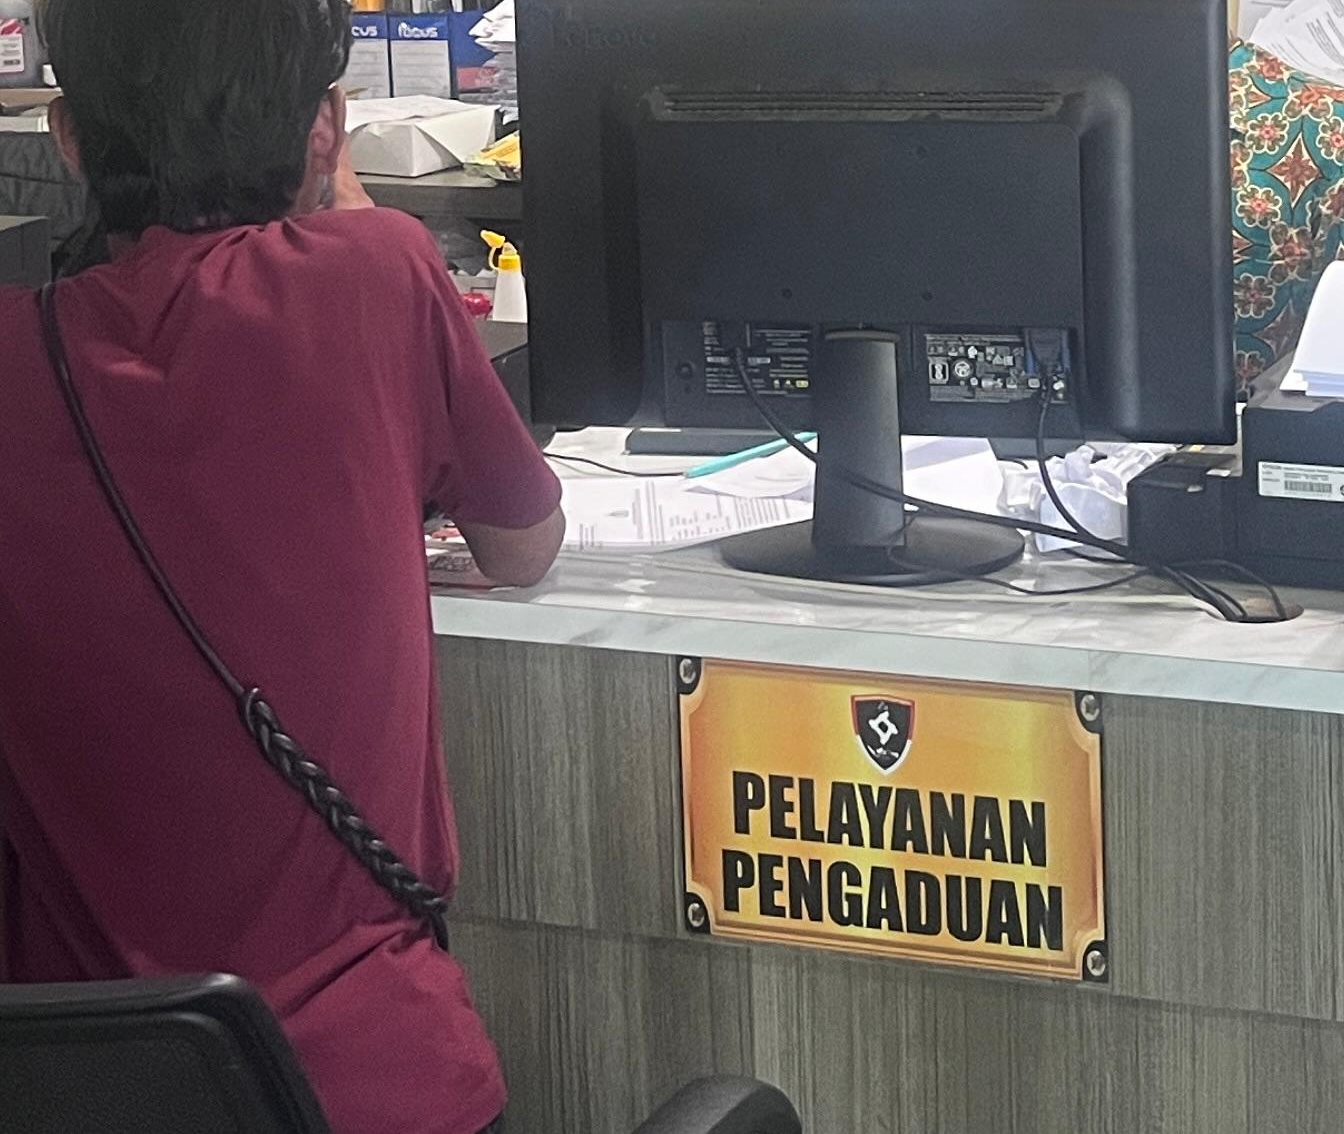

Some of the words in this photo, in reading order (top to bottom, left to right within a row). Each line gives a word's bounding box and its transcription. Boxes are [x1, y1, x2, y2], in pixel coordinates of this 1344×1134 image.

[351, 26, 378, 37] cus
[732, 770, 1048, 868] PELAYANAN
[721, 848, 1064, 952] PENGADUAN
